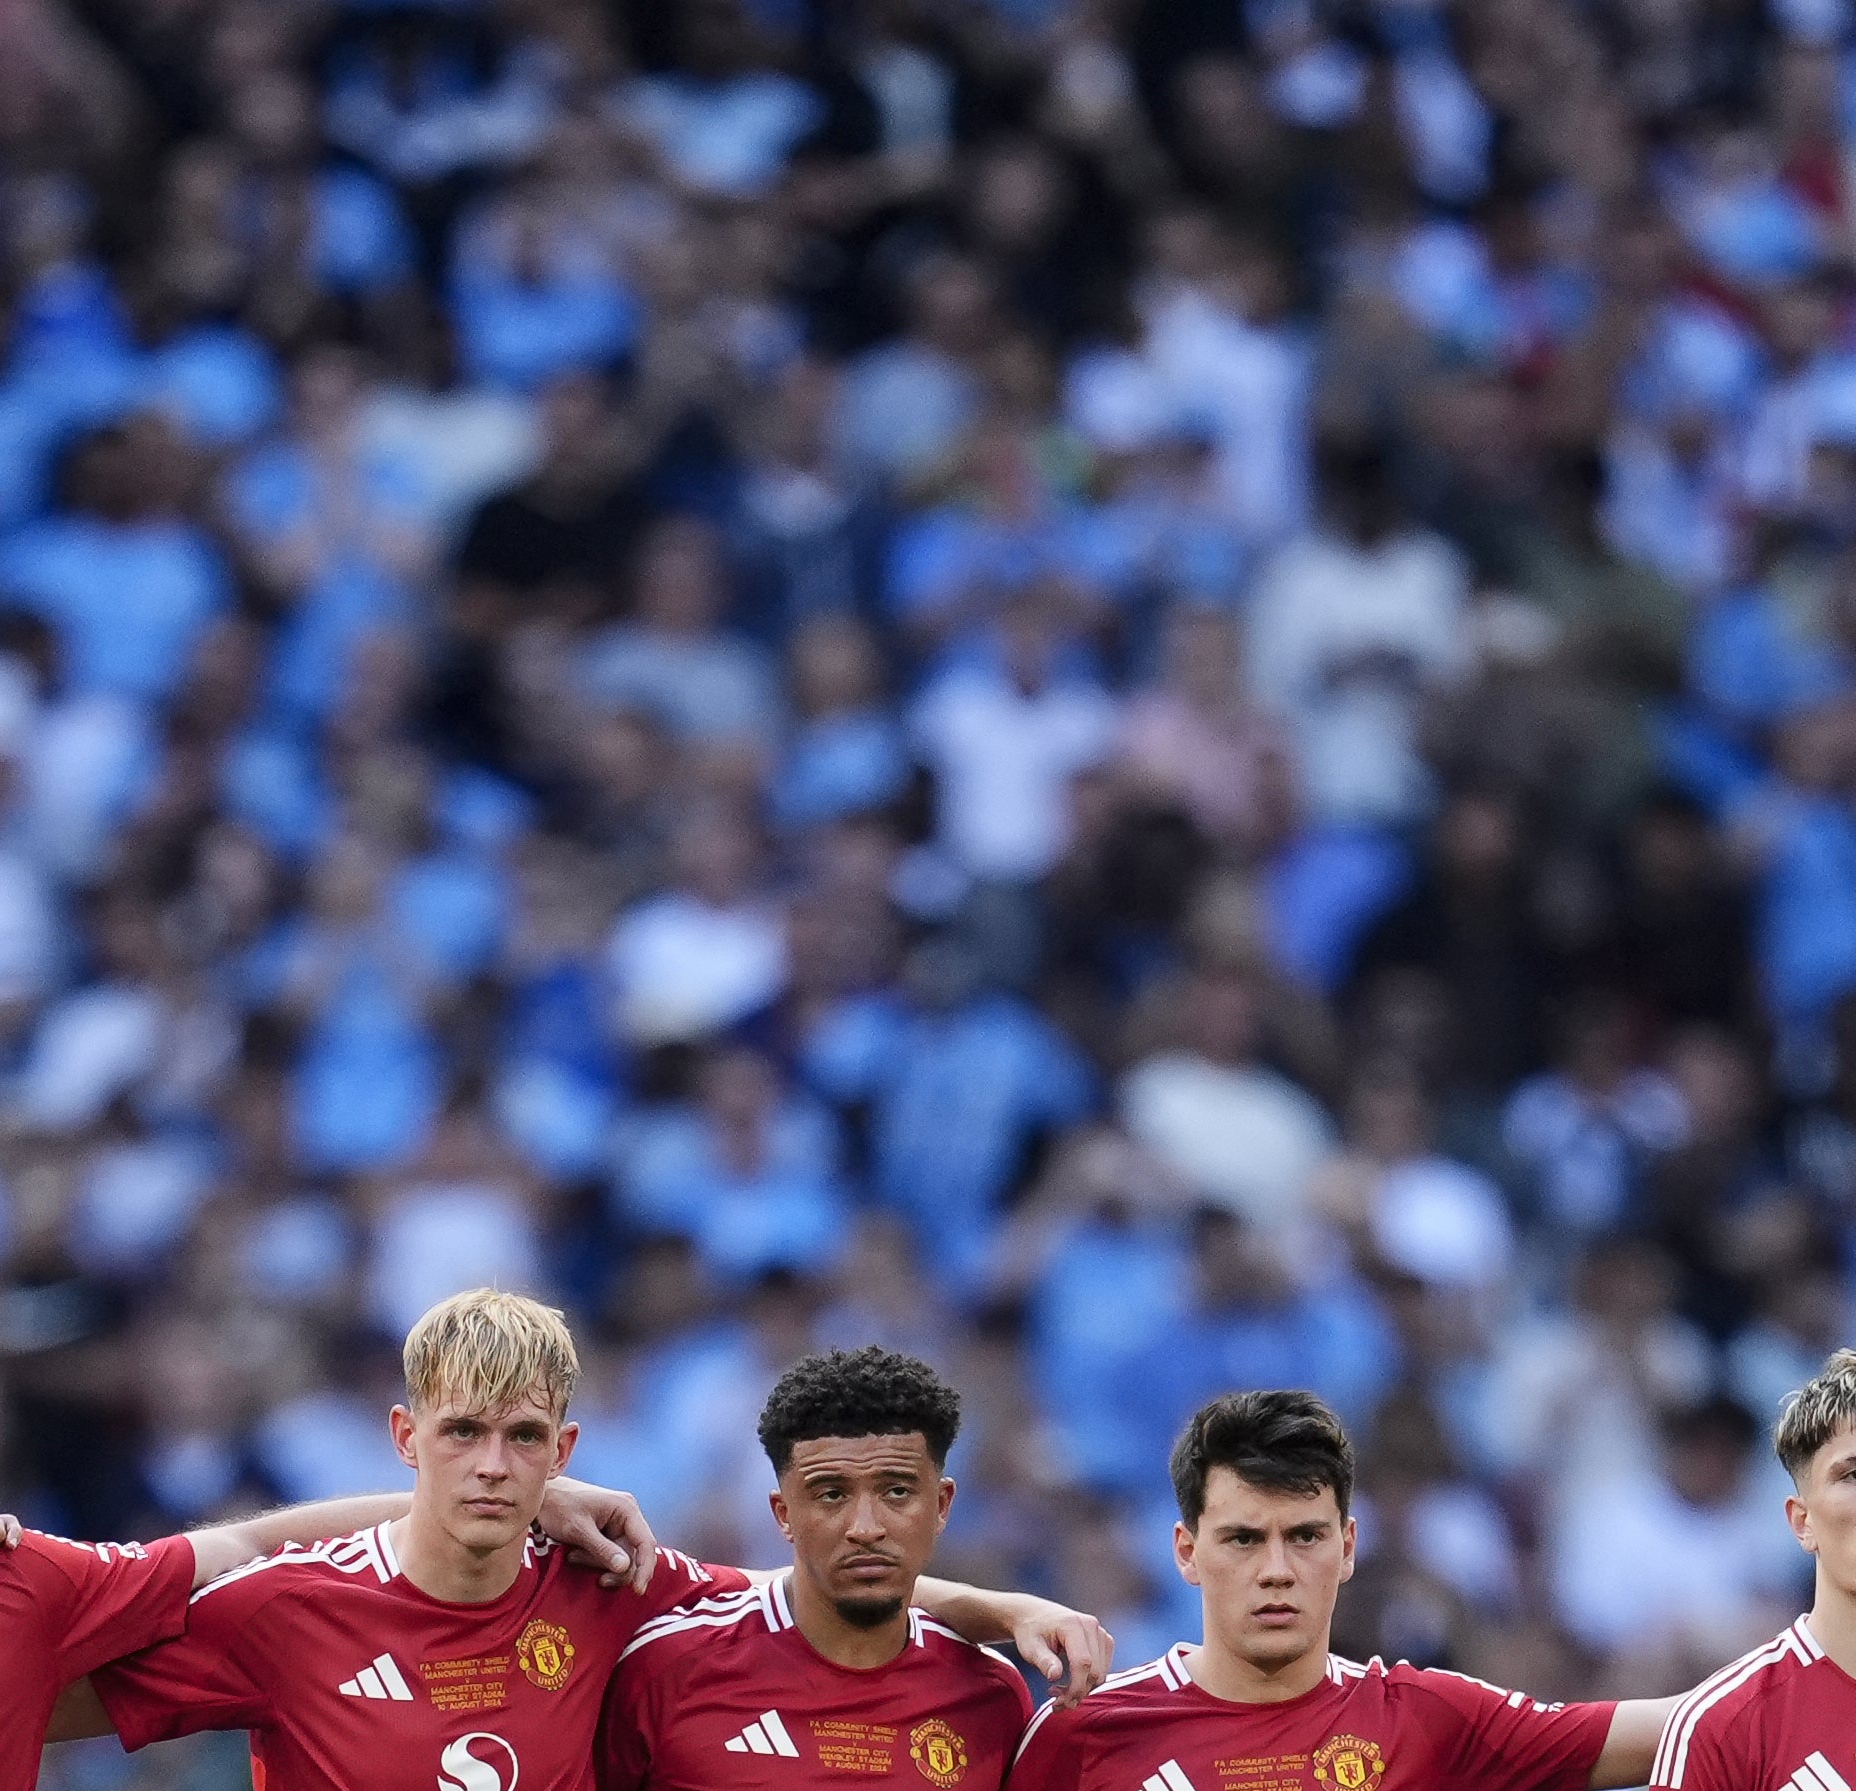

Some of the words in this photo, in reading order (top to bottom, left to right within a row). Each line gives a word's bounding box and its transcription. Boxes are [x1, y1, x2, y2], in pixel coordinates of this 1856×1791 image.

[522, 1623, 564, 1653] MANCHESTER
[538, 1669, 568, 1685] UNITED
[1320, 1737, 1376, 1763] MANCHESTER
